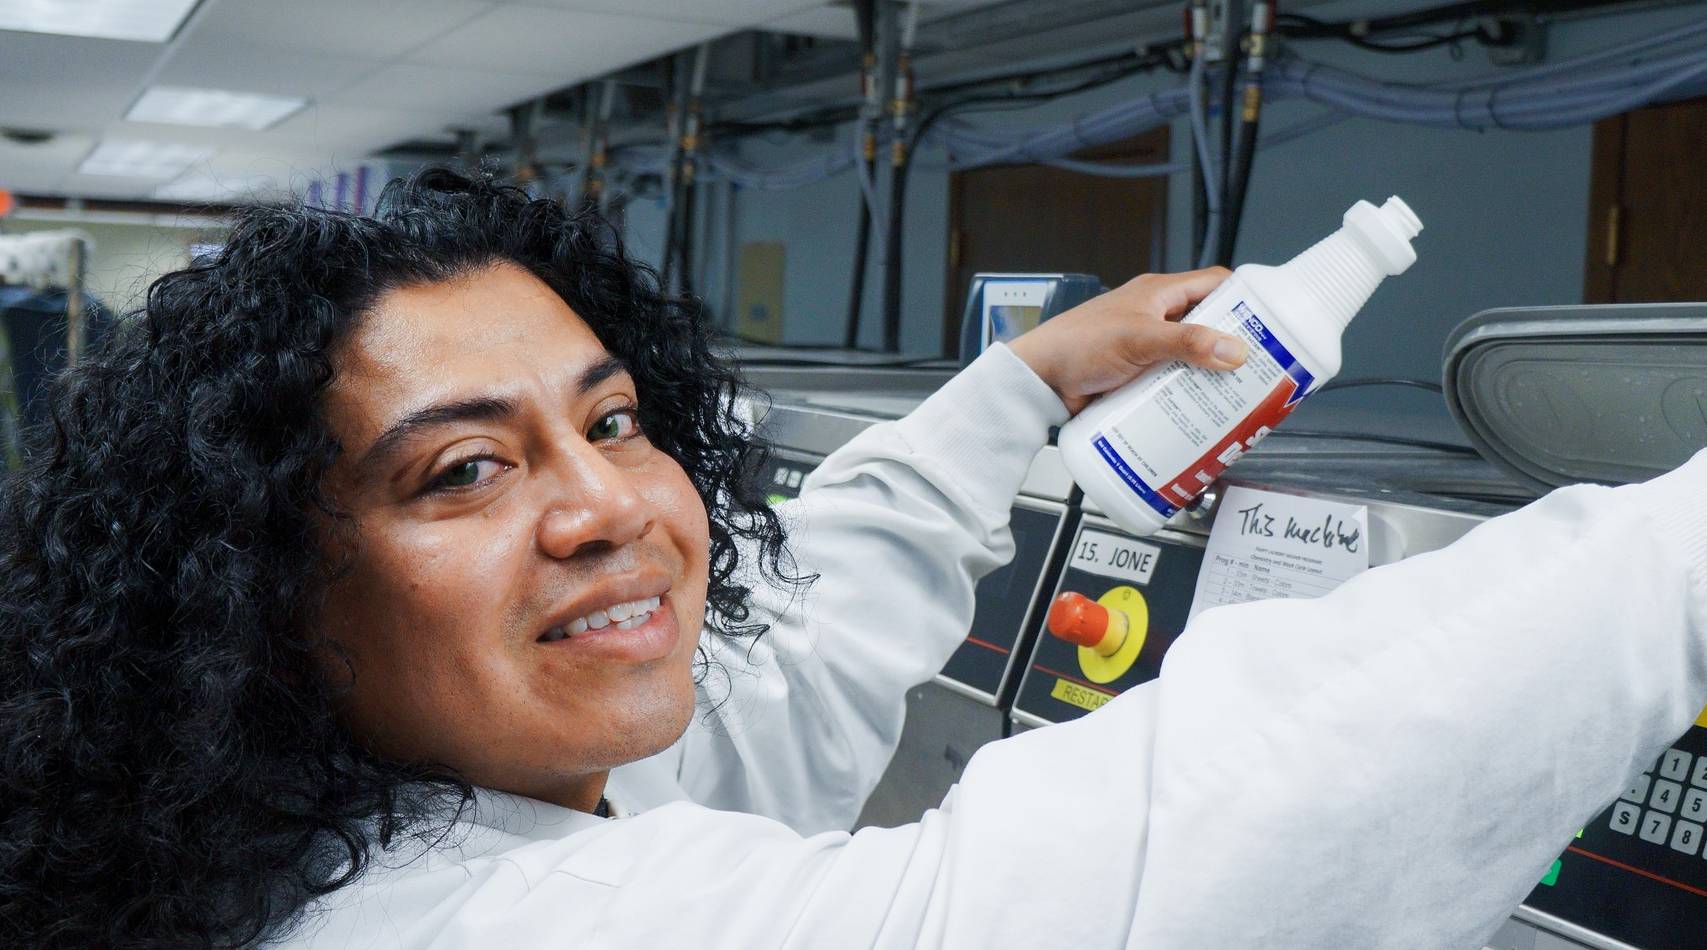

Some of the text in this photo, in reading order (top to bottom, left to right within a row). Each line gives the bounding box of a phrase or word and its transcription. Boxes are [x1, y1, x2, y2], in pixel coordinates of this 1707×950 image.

[1238, 503, 1275, 536] This
[1078, 541, 1152, 573] 15. JONE
[1064, 685, 1109, 706] RESTAR
[1672, 758, 1680, 772] 1
[1660, 789, 1702, 812] 4 5
[1619, 811, 1692, 844] S 7 8
